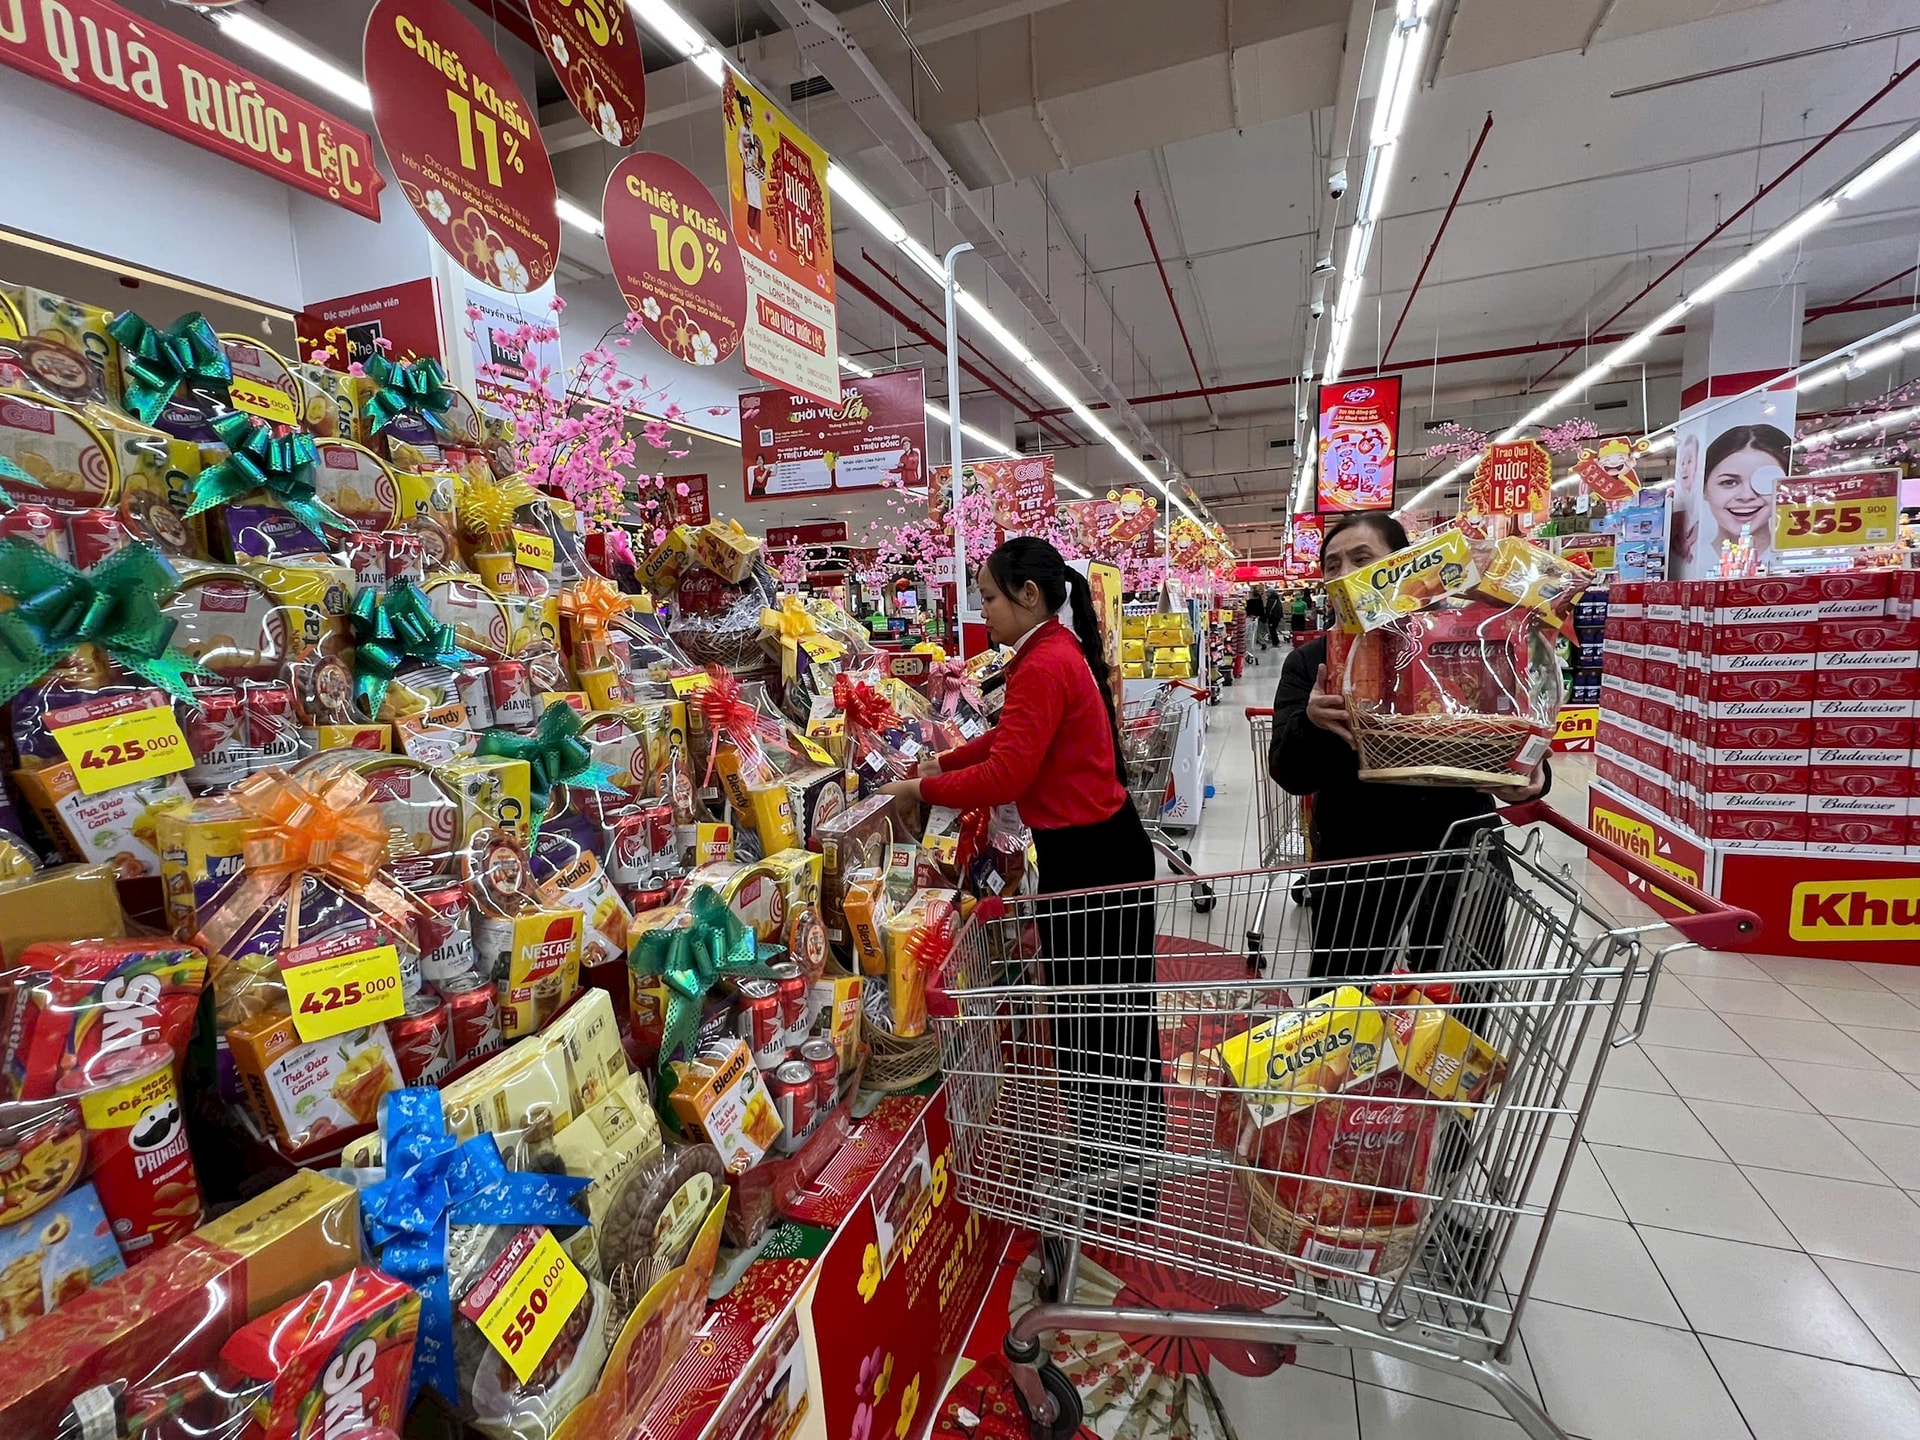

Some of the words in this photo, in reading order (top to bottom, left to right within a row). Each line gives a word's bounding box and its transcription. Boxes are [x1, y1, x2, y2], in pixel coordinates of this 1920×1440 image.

[395, 15, 469, 91] Chiết
[473, 73, 530, 140] Khấu
[177, 64, 292, 164] RƯỚC
[299, 120, 362, 199] LỘC
[424, 153, 442, 173] Cho
[443, 165, 460, 184] đơn
[402, 153, 421, 172] trên
[422, 165, 440, 184] 200
[441, 178, 461, 198] triệu
[462, 191, 483, 211] đồng
[484, 202, 498, 219] đến
[499, 213, 515, 229] 400
[515, 220, 531, 239] triệu
[532, 231, 549, 251] đồng
[625, 174, 680, 219] Chiết
[682, 204, 728, 245] Khấu
[743, 256, 762, 277] Thông
[627, 274, 641, 288] trên
[641, 279, 654, 293] 100
[696, 303, 709, 317] 200
[769, 286, 785, 304] LONG
[760, 299, 779, 329] Trao
[781, 315, 796, 338] quà
[783, 451, 803, 460] TRIỆU
[861, 441, 879, 451] TRIỆU
[1495, 447, 1512, 458] Trao
[1514, 445, 1529, 458] Quà
[1495, 459, 1528, 481] RƯỚC
[1019, 494, 1043, 511] TẾT
[1495, 481, 1526, 515] LỘC
[645, 545, 674, 577] Custas
[938, 565, 948, 574] 30
[1370, 549, 1445, 591] Custas
[1730, 606, 1814, 621] Budweiser
[1819, 601, 1879, 615] udweiser
[1728, 655, 1809, 669] Budweiser
[1824, 652, 1912, 666] Budweiser
[111, 696, 133, 708] TẾT
[503, 699, 521, 711] BIA
[1723, 702, 1806, 716] Budweiser
[1820, 700, 1907, 714] Budweiser
[201, 751, 228, 766] BIA
[1722, 749, 1803, 763] Budweiser
[1817, 749, 1903, 762] Budweiser
[726, 773, 748, 811] Blendy
[1724, 795, 1796, 808] Budweiser
[76, 808, 99, 821] Trà
[100, 797, 124, 811] Đào
[1819, 798, 1896, 811] Budweiser
[88, 816, 112, 830] Cam
[112, 808, 127, 820] Sả
[1595, 815, 1650, 859] Khuyến
[555, 859, 592, 891] Blendy
[1802, 892, 1920, 927] Khu
[341, 934, 362, 948] TẾT
[432, 945, 456, 962] BIA
[791, 1019, 806, 1033] BIA
[1294, 1026, 1325, 1049] ORION
[763, 1044, 780, 1055] BIA
[1266, 1026, 1353, 1081] Custas
[282, 1070, 304, 1087] Trà
[303, 1055, 330, 1072] Đào
[712, 1053, 746, 1096] Blendy
[1433, 1056, 1461, 1088] PHIN
[142, 1073, 169, 1093] MORE
[291, 1080, 316, 1096] Cam
[316, 1069, 331, 1082] Sả
[134, 1128, 190, 1179] PRINGLES
[902, 1206, 933, 1264] Khấu
[505, 1237, 526, 1260] TẾT
[938, 1232, 965, 1291] Chiết
[938, 1256, 965, 1314] Khấu
[502, 1257, 566, 1356] 550.000
